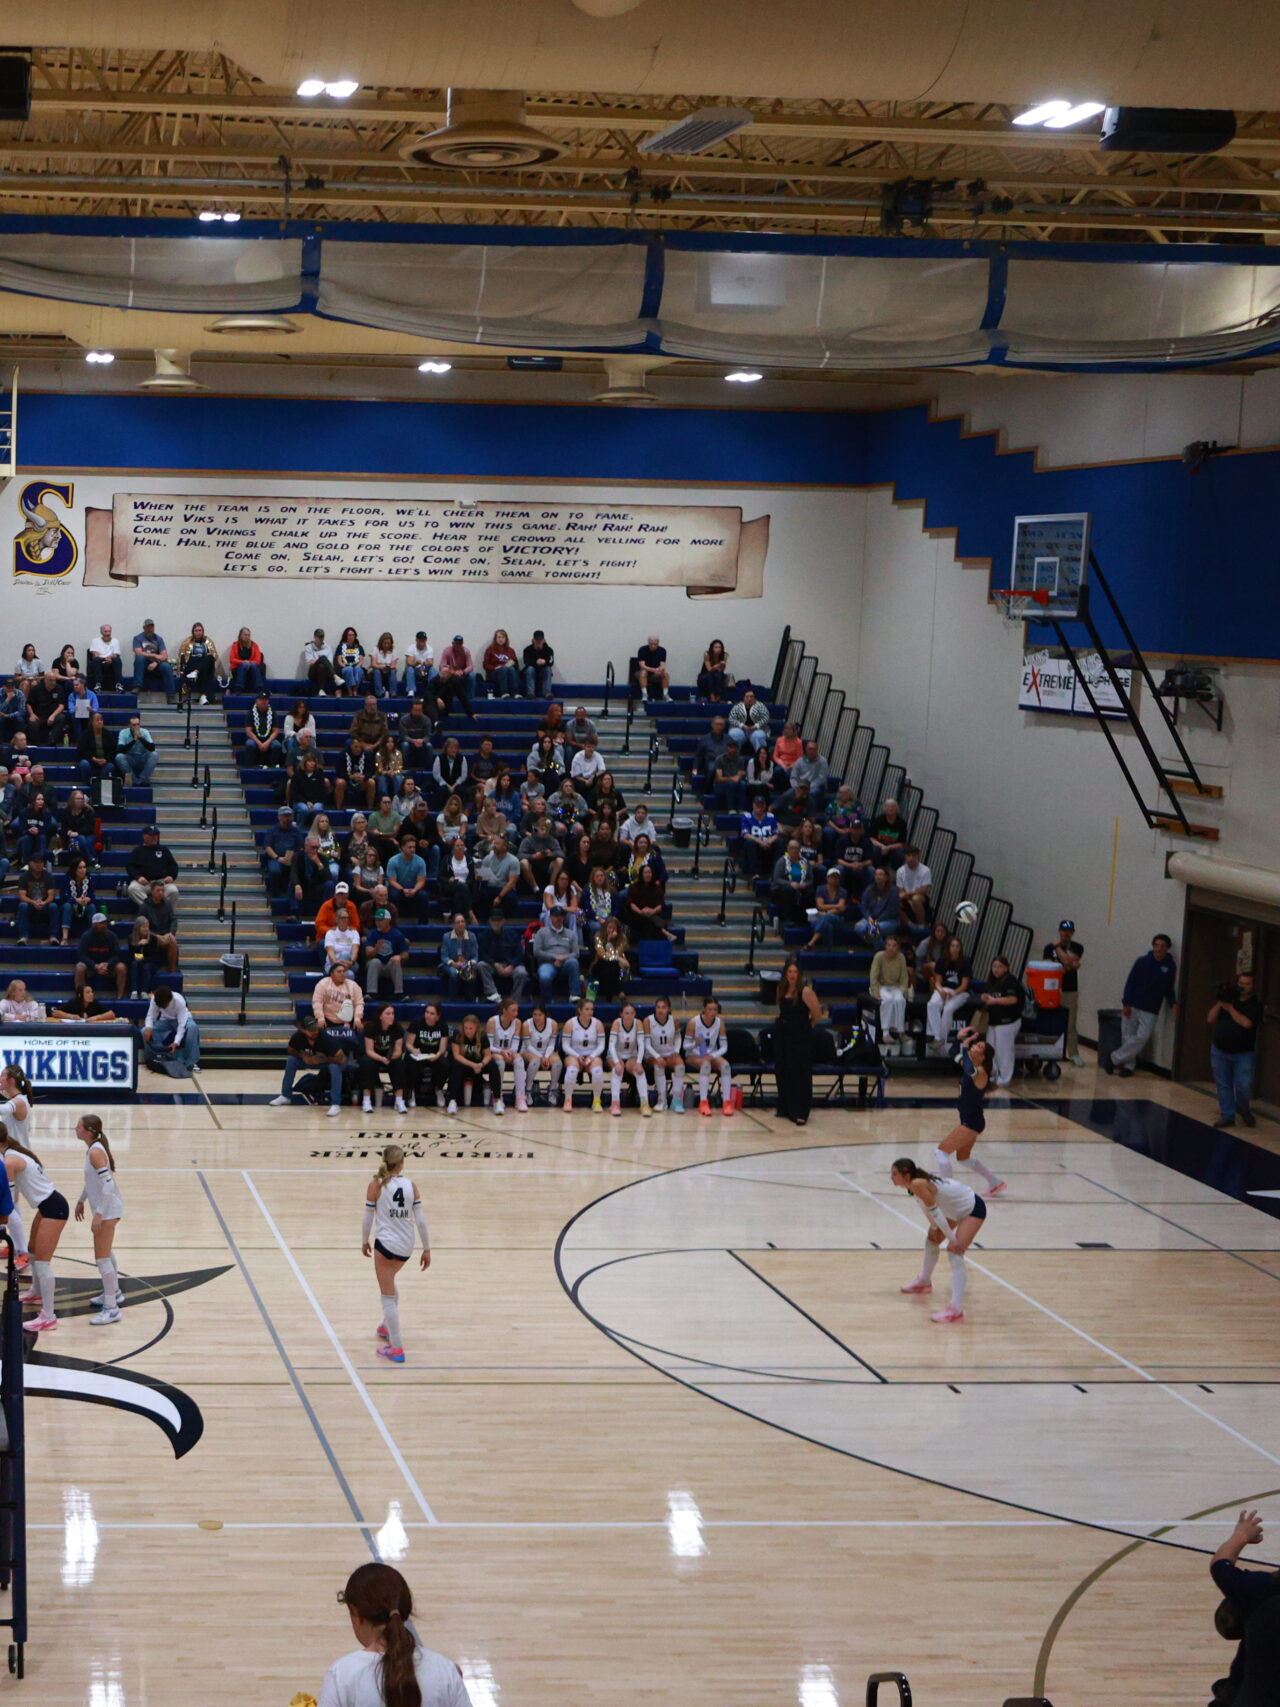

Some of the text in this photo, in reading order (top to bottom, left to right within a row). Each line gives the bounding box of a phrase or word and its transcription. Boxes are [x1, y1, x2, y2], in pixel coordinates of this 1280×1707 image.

[133, 501, 174, 511] WHEN
[184, 504, 207, 512] THE
[217, 504, 249, 512] TEAM
[258, 505, 270, 513] IS
[396, 507, 432, 517] WE'LL
[443, 510, 485, 518] CHEER
[541, 511, 559, 519] ON
[133, 513, 174, 522] SELAH
[183, 514, 215, 523] VIKS
[254, 517, 288, 525] WHAT
[317, 518, 356, 527] TAKES
[398, 520, 415, 528] US
[449, 521, 475, 529] WIN
[484, 522, 513, 530] THIS
[565, 522, 597, 531] RAH!
[602, 523, 633, 532] RAH!
[637, 524, 668, 533] RAH!
[133, 525, 171, 535] COME
[206, 527, 257, 536] VIKINGS
[271, 530, 310, 538] CHALK
[432, 532, 468, 541] HEAR
[477, 534, 501, 542] THE
[510, 535, 556, 543] CROWD
[563, 536, 585, 544] ALL
[597, 537, 646, 545] YELLING
[689, 538, 726, 546] MORE
[215, 540, 238, 548] THE
[245, 541, 276, 549] BLUE
[283, 542, 309, 550] AND
[357, 543, 381, 551] FOR
[421, 545, 470, 553] COLORS
[502, 545, 580, 555] VICTORY!
[224, 551, 262, 560] COME
[353, 554, 385, 563] LET'S
[392, 555, 415, 564] GO!
[423, 555, 461, 564] COME
[556, 559, 590, 567] LET'S
[599, 560, 638, 568] FIGHT!
[223, 563, 258, 572] LET'S
[298, 565, 331, 574] LET'S
[339, 567, 374, 575] FIGHT
[387, 567, 420, 576] LET'S
[428, 568, 458, 576] WIN
[461, 569, 489, 577] THIS
[501, 570, 534, 578] GAME
[544, 571, 601, 579] TONIGHT!
[1022, 664, 1073, 706] EXTREME
[2, 1050, 130, 1081] VIKINGS
[439, 1151, 536, 1159] FERD
[393, 1187, 405, 1207] 4
